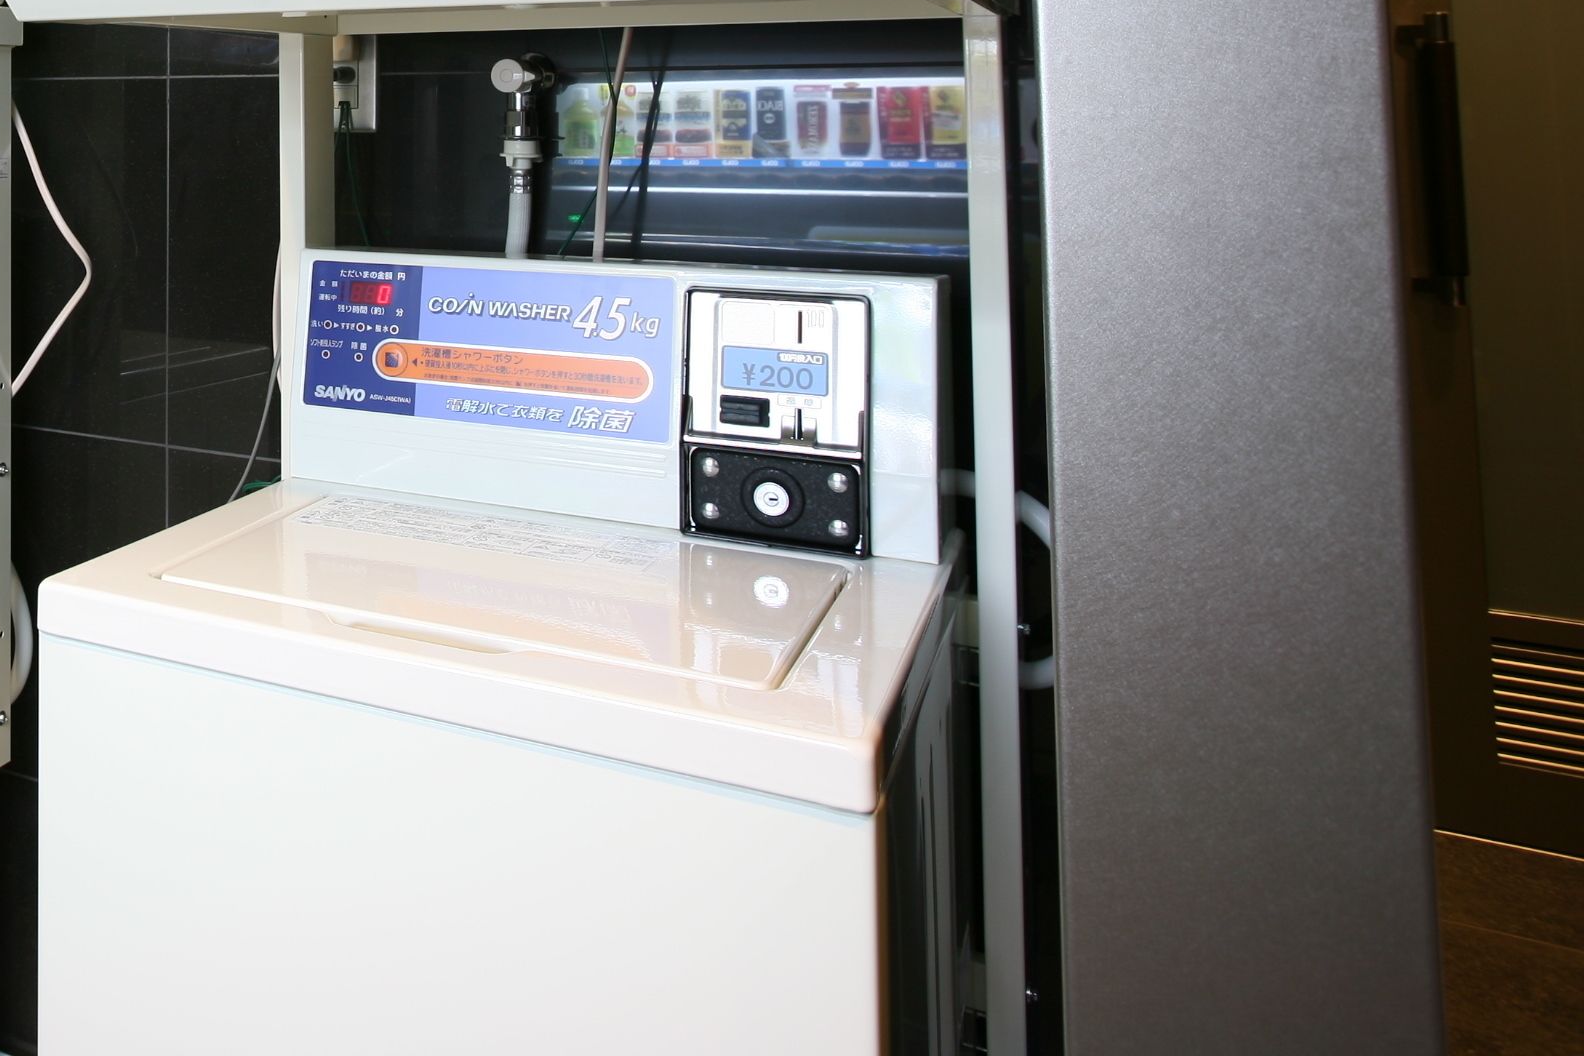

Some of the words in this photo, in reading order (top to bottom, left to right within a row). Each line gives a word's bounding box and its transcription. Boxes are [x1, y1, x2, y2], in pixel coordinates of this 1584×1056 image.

[340, 269, 393, 281] ただいまの金額
[397, 272, 406, 282] 円
[395, 307, 404, 318] 分
[488, 301, 573, 323] WASHER
[421, 347, 524, 366] 洗濯槽シャワーボタン
[742, 362, 814, 390] ¥200
[314, 384, 366, 402] SANYO
[446, 397, 565, 422] 電解水で衣類を
[567, 405, 635, 433] 除菌
